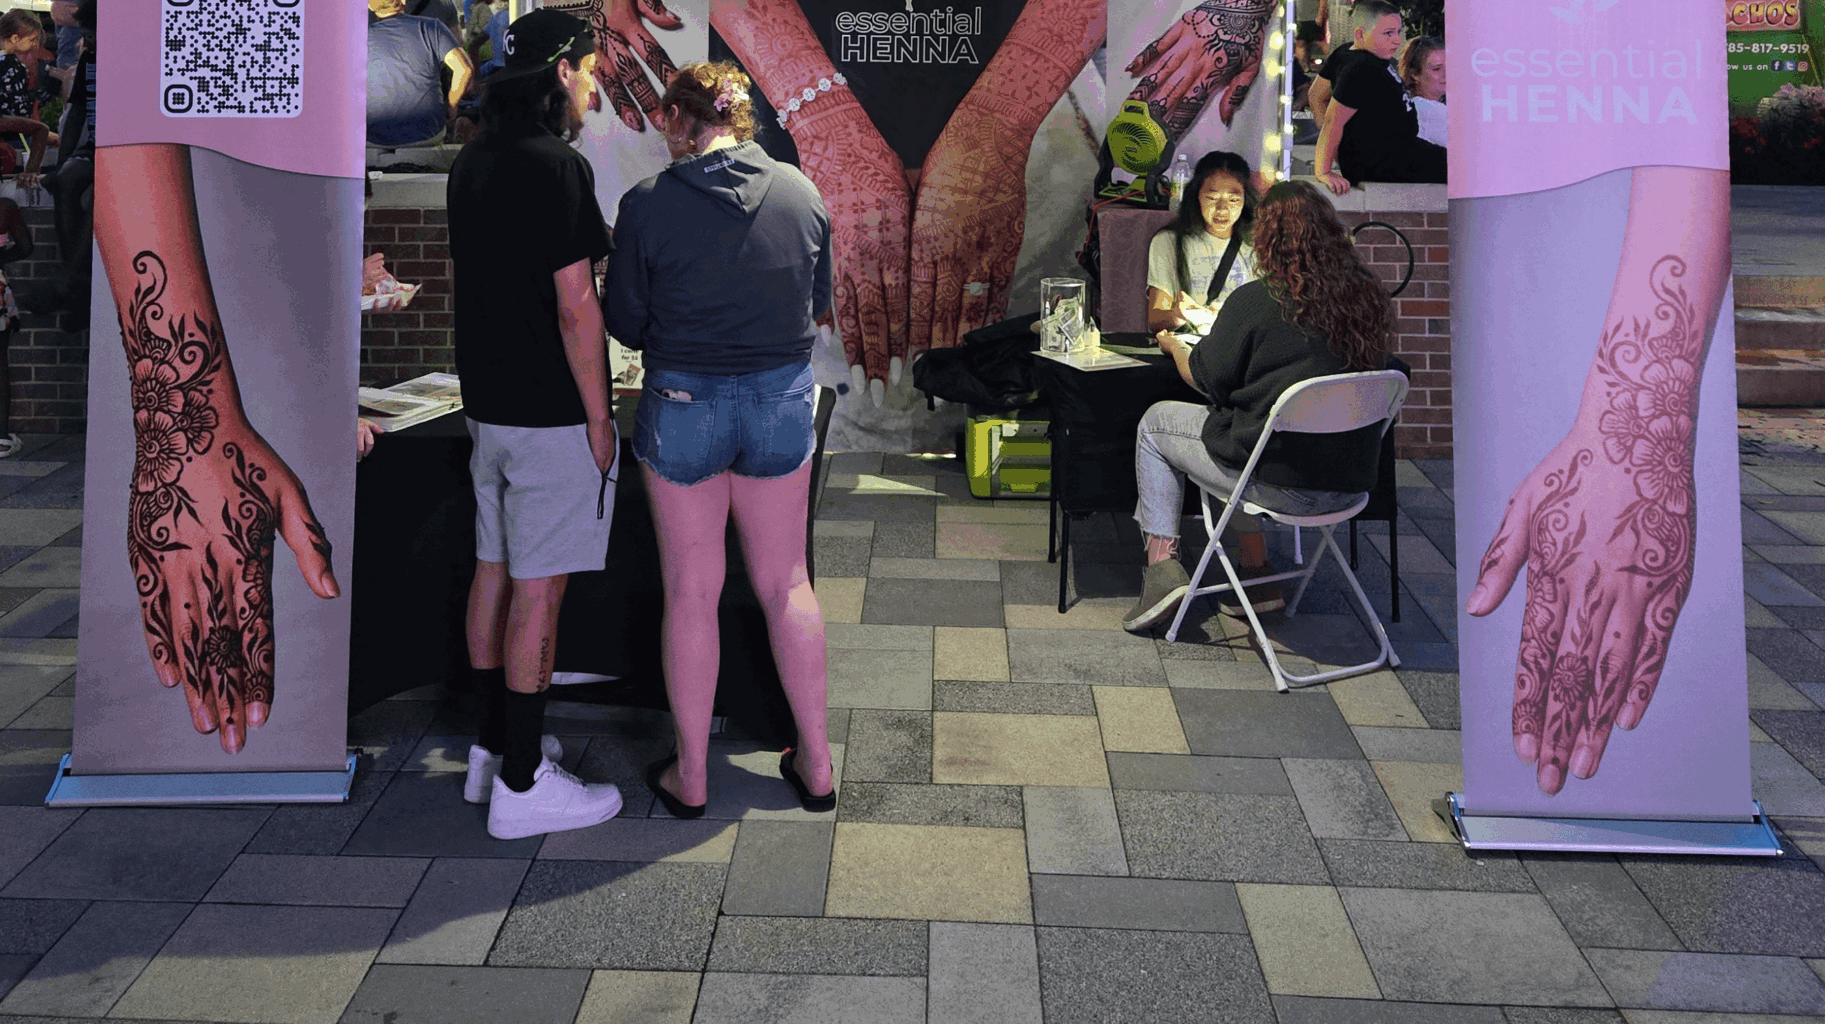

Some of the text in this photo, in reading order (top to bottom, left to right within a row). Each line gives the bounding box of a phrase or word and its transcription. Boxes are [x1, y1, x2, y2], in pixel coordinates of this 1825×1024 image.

[836, 6, 982, 35] essential
[841, 34, 979, 64] HENNA
[1471, 39, 1701, 79] essential
[1727, 42, 1810, 54] 85-817-9519
[1481, 83, 1698, 125] HENNA
